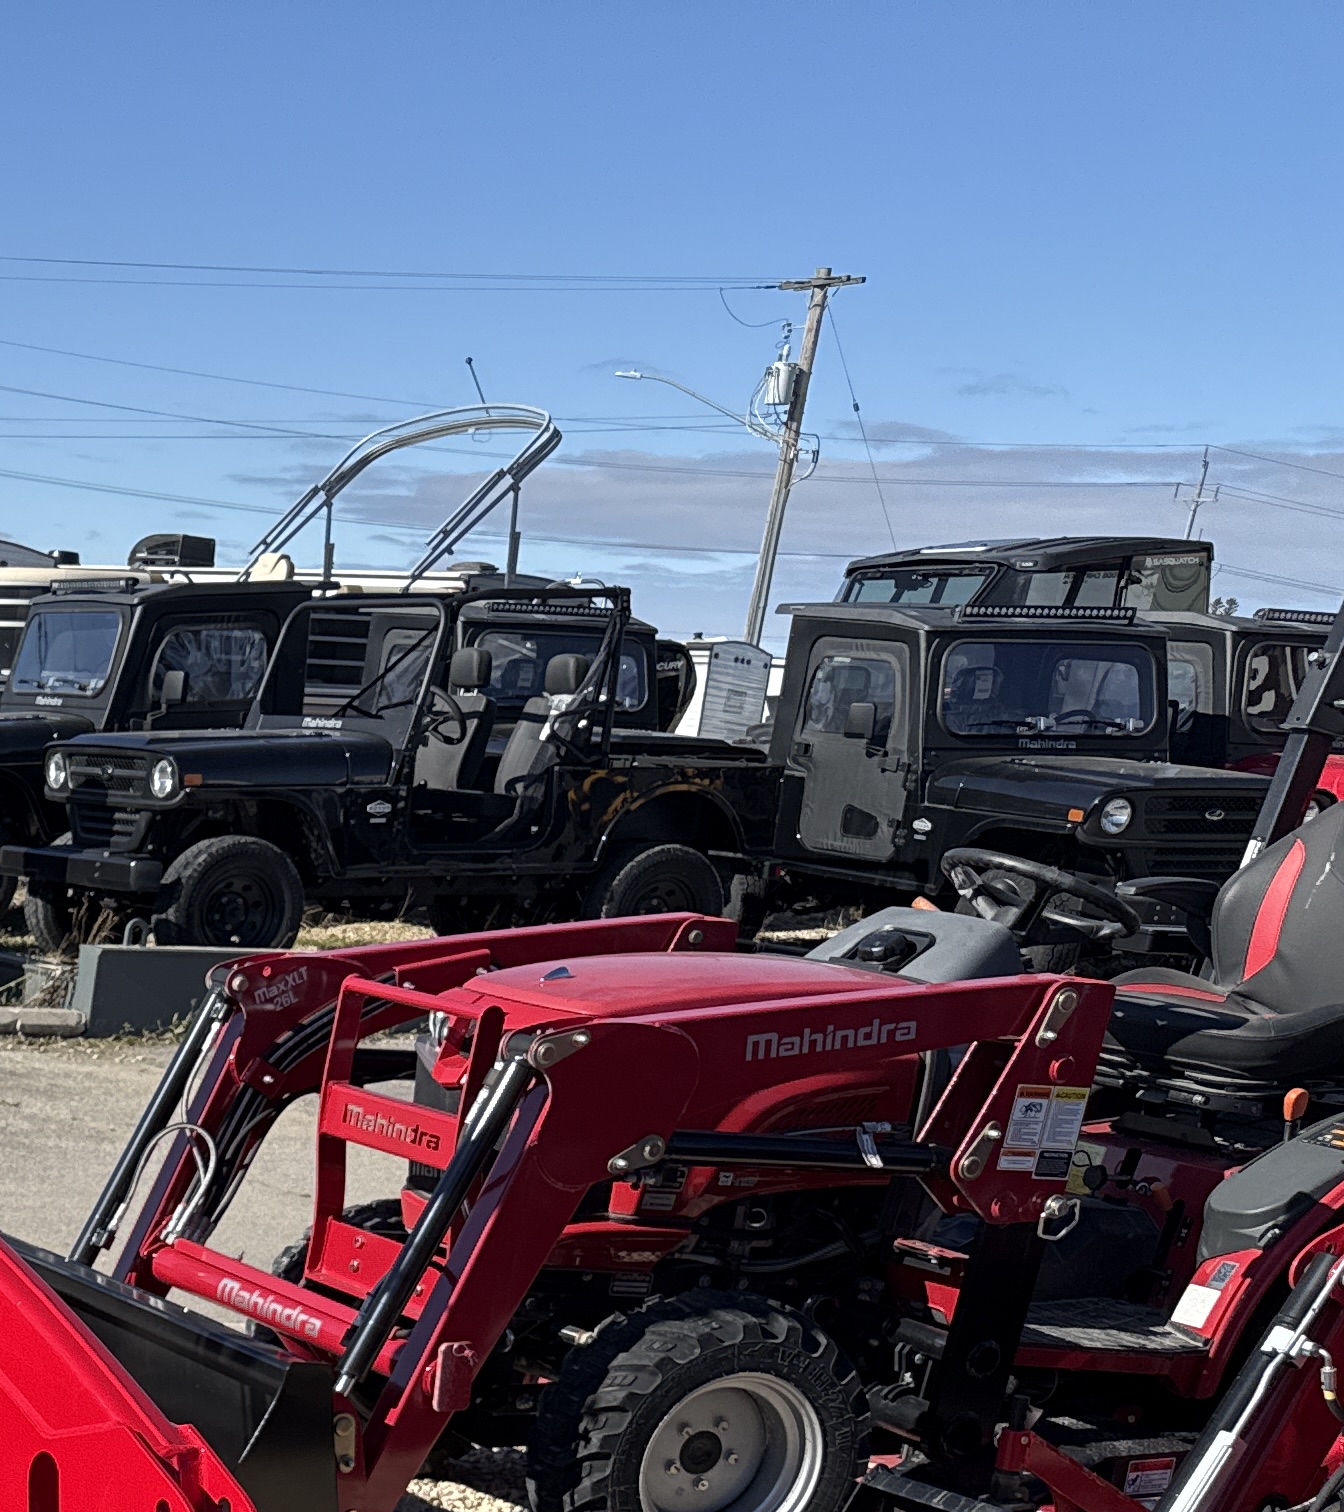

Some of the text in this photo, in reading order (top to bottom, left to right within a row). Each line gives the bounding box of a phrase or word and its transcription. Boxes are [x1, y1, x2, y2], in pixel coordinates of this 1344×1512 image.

[656, 660, 684, 671] CURY
[1018, 738, 1077, 749] Mahindra
[745, 1018, 917, 1062] Mahindra
[342, 1103, 441, 1151] Mahindra
[216, 1277, 323, 1338] Mahindra
